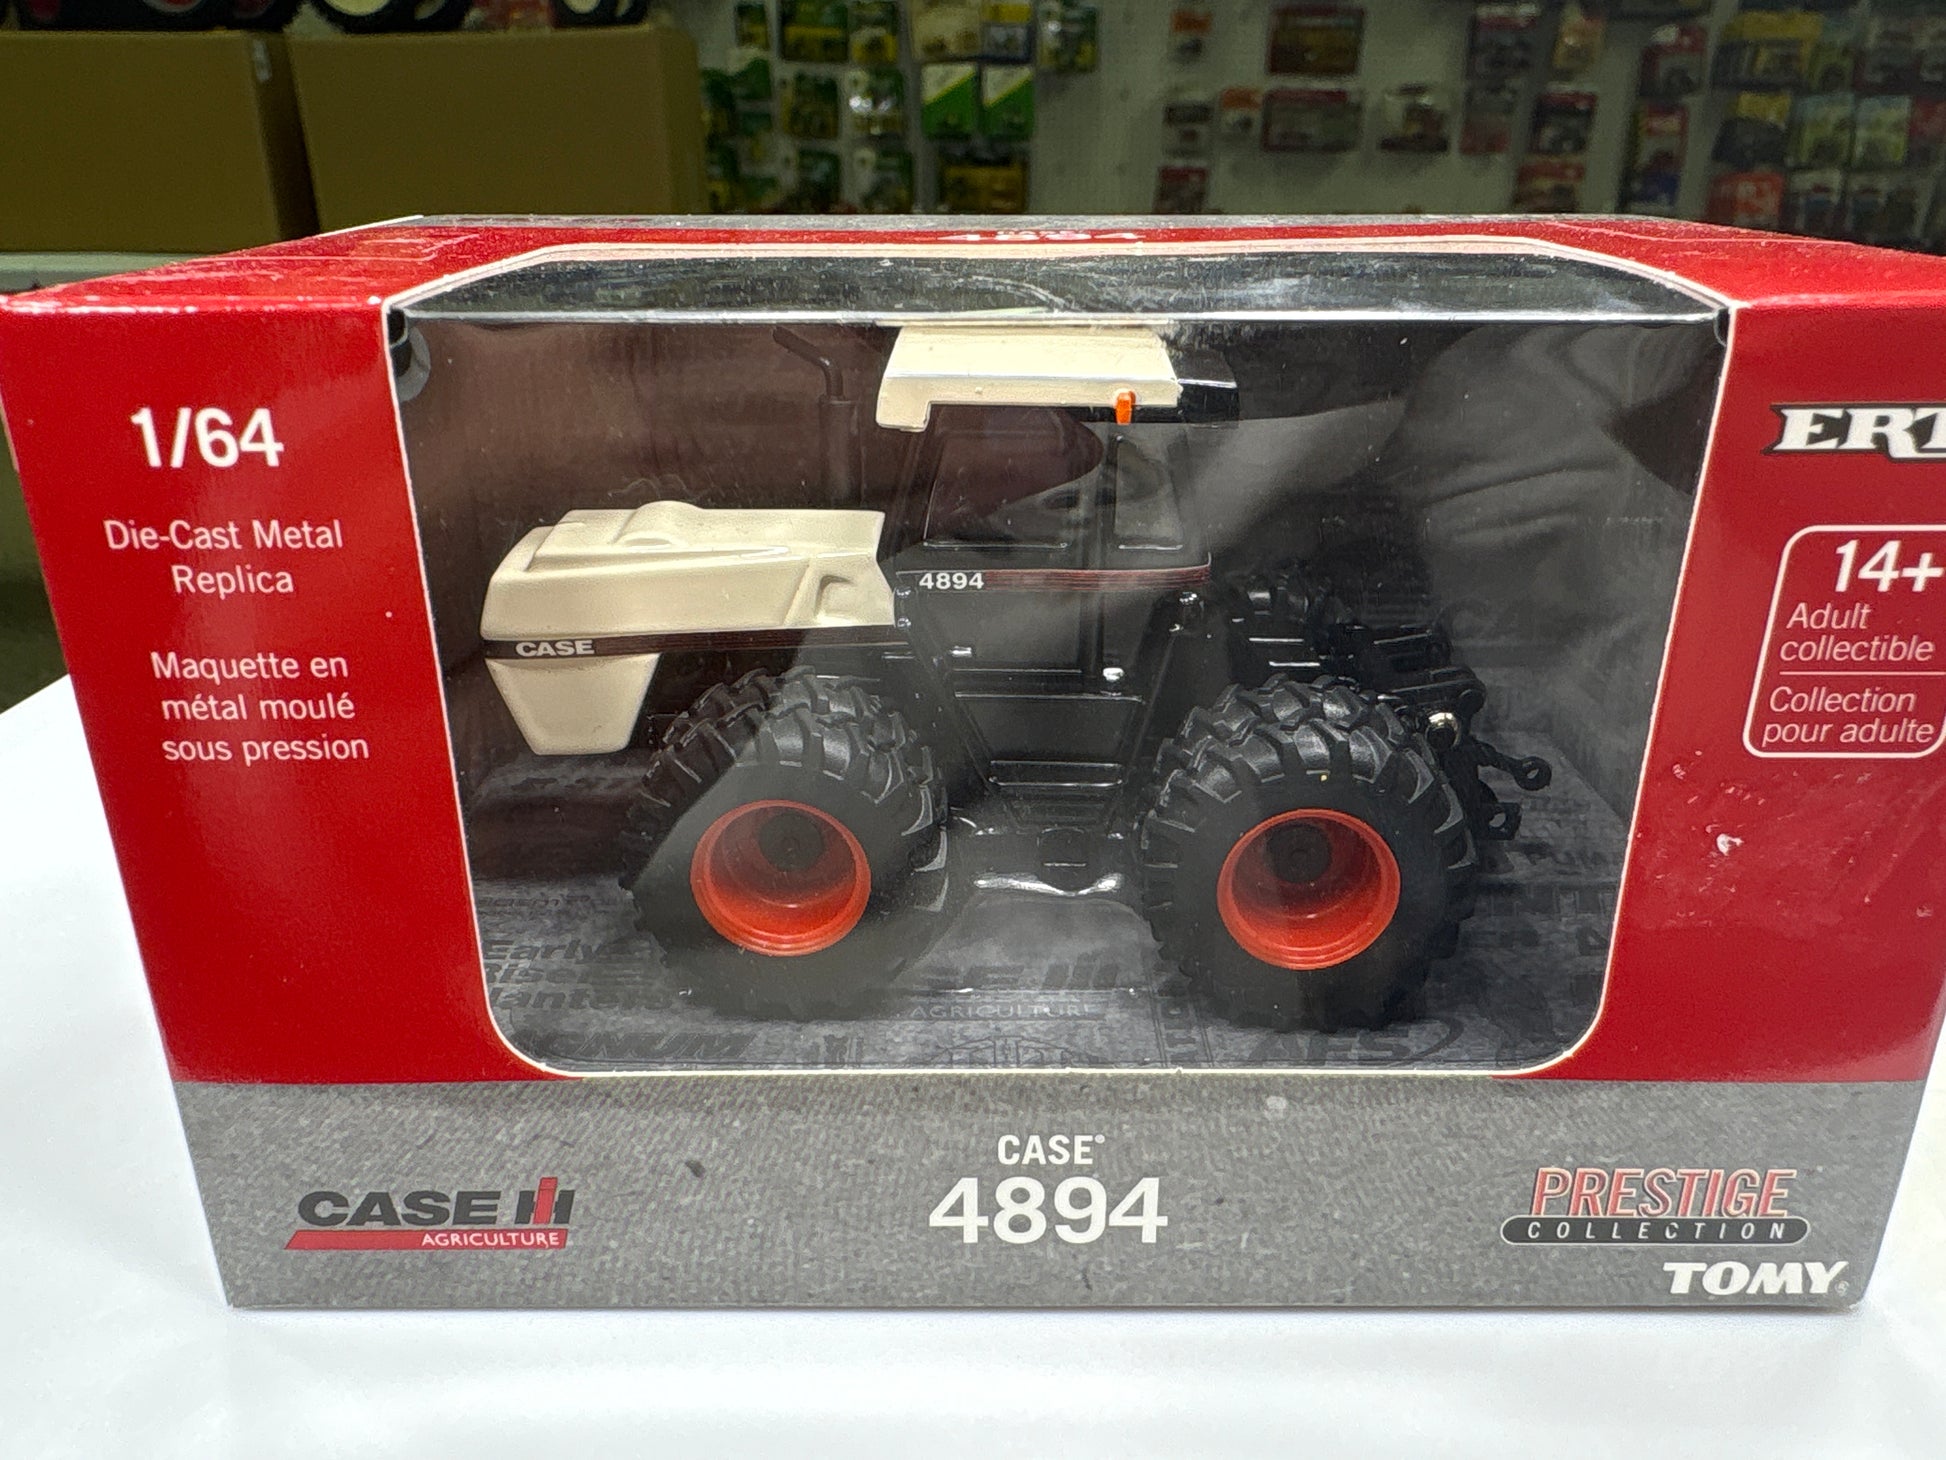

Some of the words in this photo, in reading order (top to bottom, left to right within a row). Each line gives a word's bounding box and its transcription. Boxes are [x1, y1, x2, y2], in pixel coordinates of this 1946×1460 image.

[130, 406, 285, 468] 1/64
[103, 519, 242, 550] Die-Cast
[252, 519, 343, 549] Metal
[1834, 538, 1944, 593] 14+
[171, 564, 294, 600] Replica
[918, 572, 986, 591] 4894
[1785, 602, 1872, 630] Adult
[514, 639, 596, 658] CASE
[1778, 635, 1935, 662] collectible
[150, 651, 300, 685] Maquette
[310, 656, 349, 679] en
[161, 693, 248, 721] métal
[259, 692, 356, 720] moulé
[1768, 686, 1916, 713] Collection
[1761, 723, 1833, 748] pour
[1838, 718, 1935, 744] adulte
[161, 739, 233, 762] sous
[242, 733, 370, 767] pression
[1528, 1167, 1798, 1218] PRESTIGE
[298, 1190, 500, 1227] CASE
[929, 1175, 1169, 1245] 4894
[421, 1231, 560, 1248] AGRICULTURE
[1526, 1221, 1787, 1241] COLLECTION
[1662, 1260, 1849, 1296] TOMY
